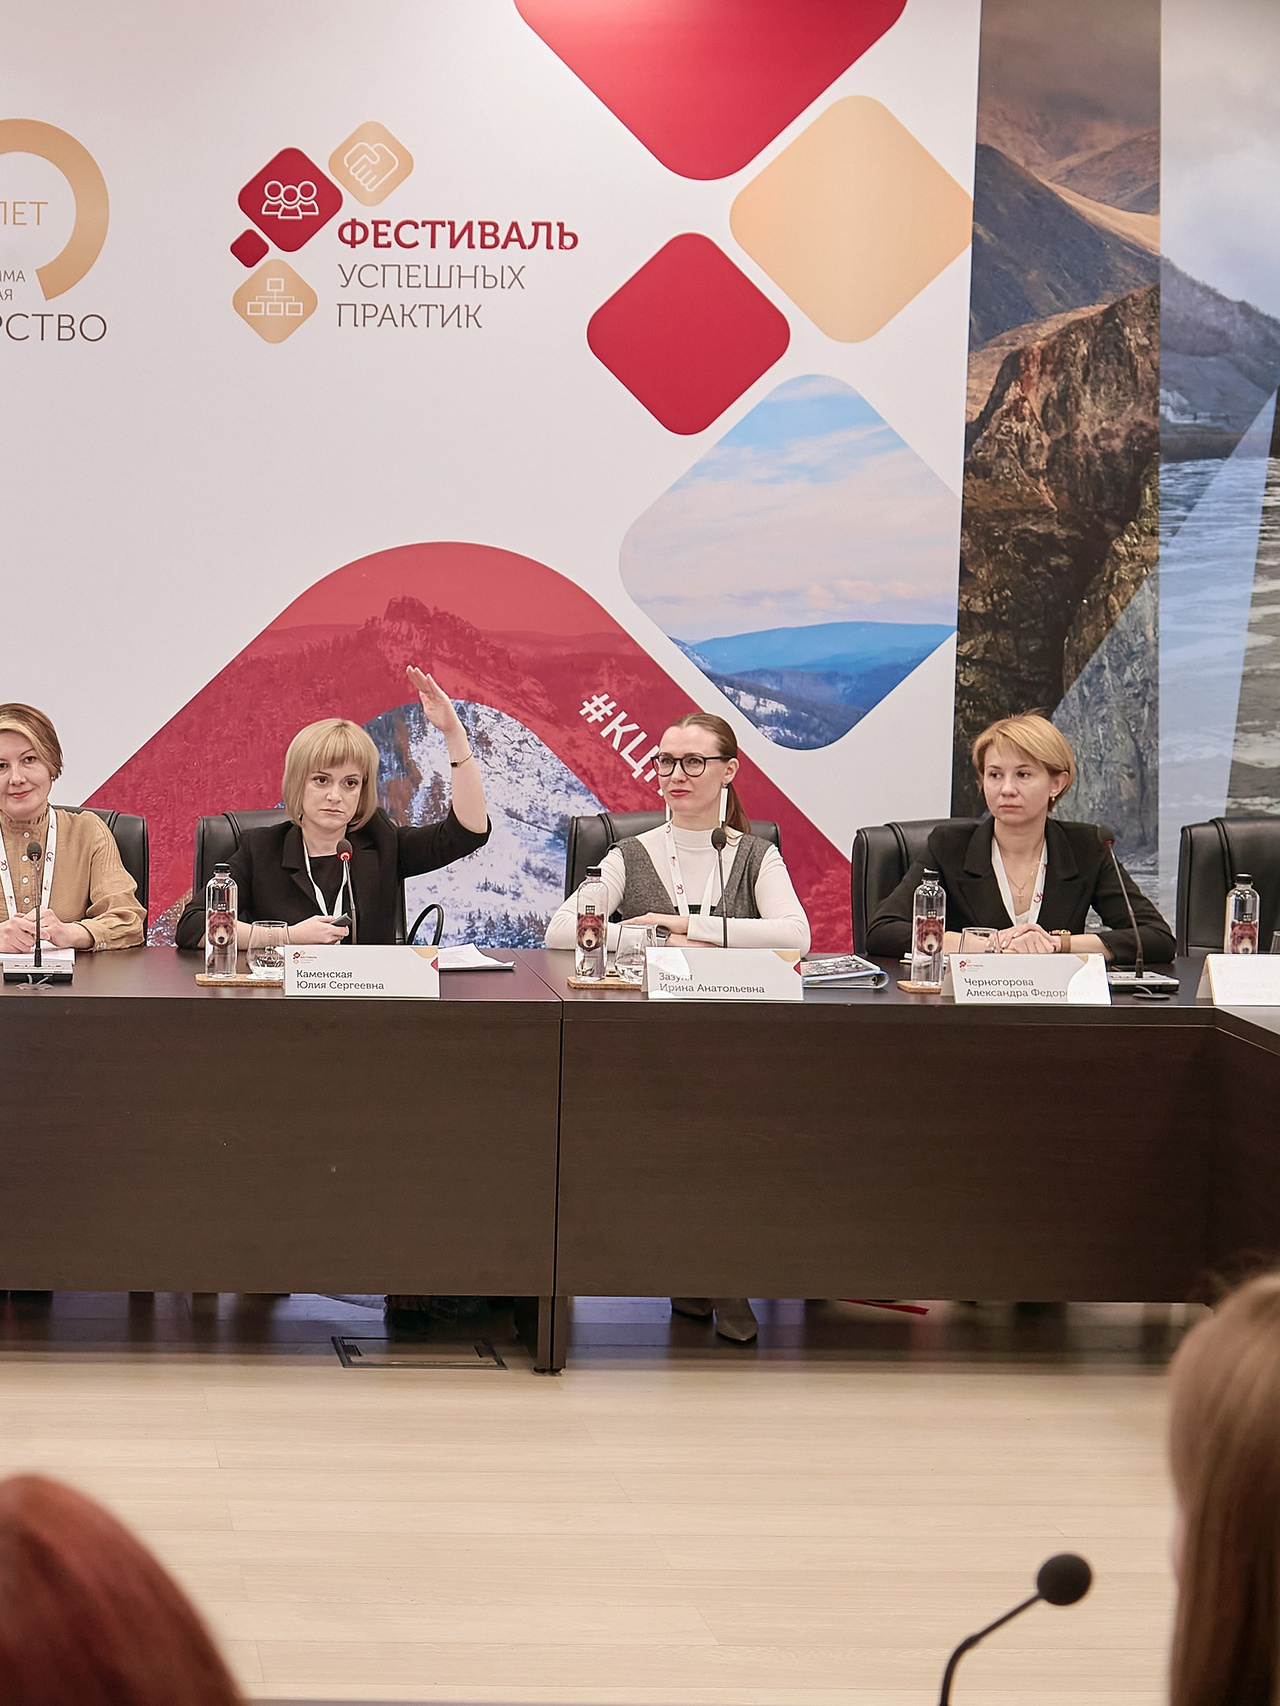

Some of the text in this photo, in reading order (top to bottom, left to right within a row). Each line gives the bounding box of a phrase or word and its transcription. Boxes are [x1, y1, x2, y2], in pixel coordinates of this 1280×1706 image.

[338, 218, 578, 250] ФЕСТИВАЛЬ
[338, 264, 525, 289] УСПЕШНЫХ
[337, 303, 482, 328] ПРАКТИК
[297, 970, 352, 978] Каменская
[297, 981, 384, 991] Юлия Сергеевна
[964, 978, 1034, 987] Черногорова
[660, 983, 764, 993] Ирина Анатольевна
[966, 989, 1028, 998] Александра
